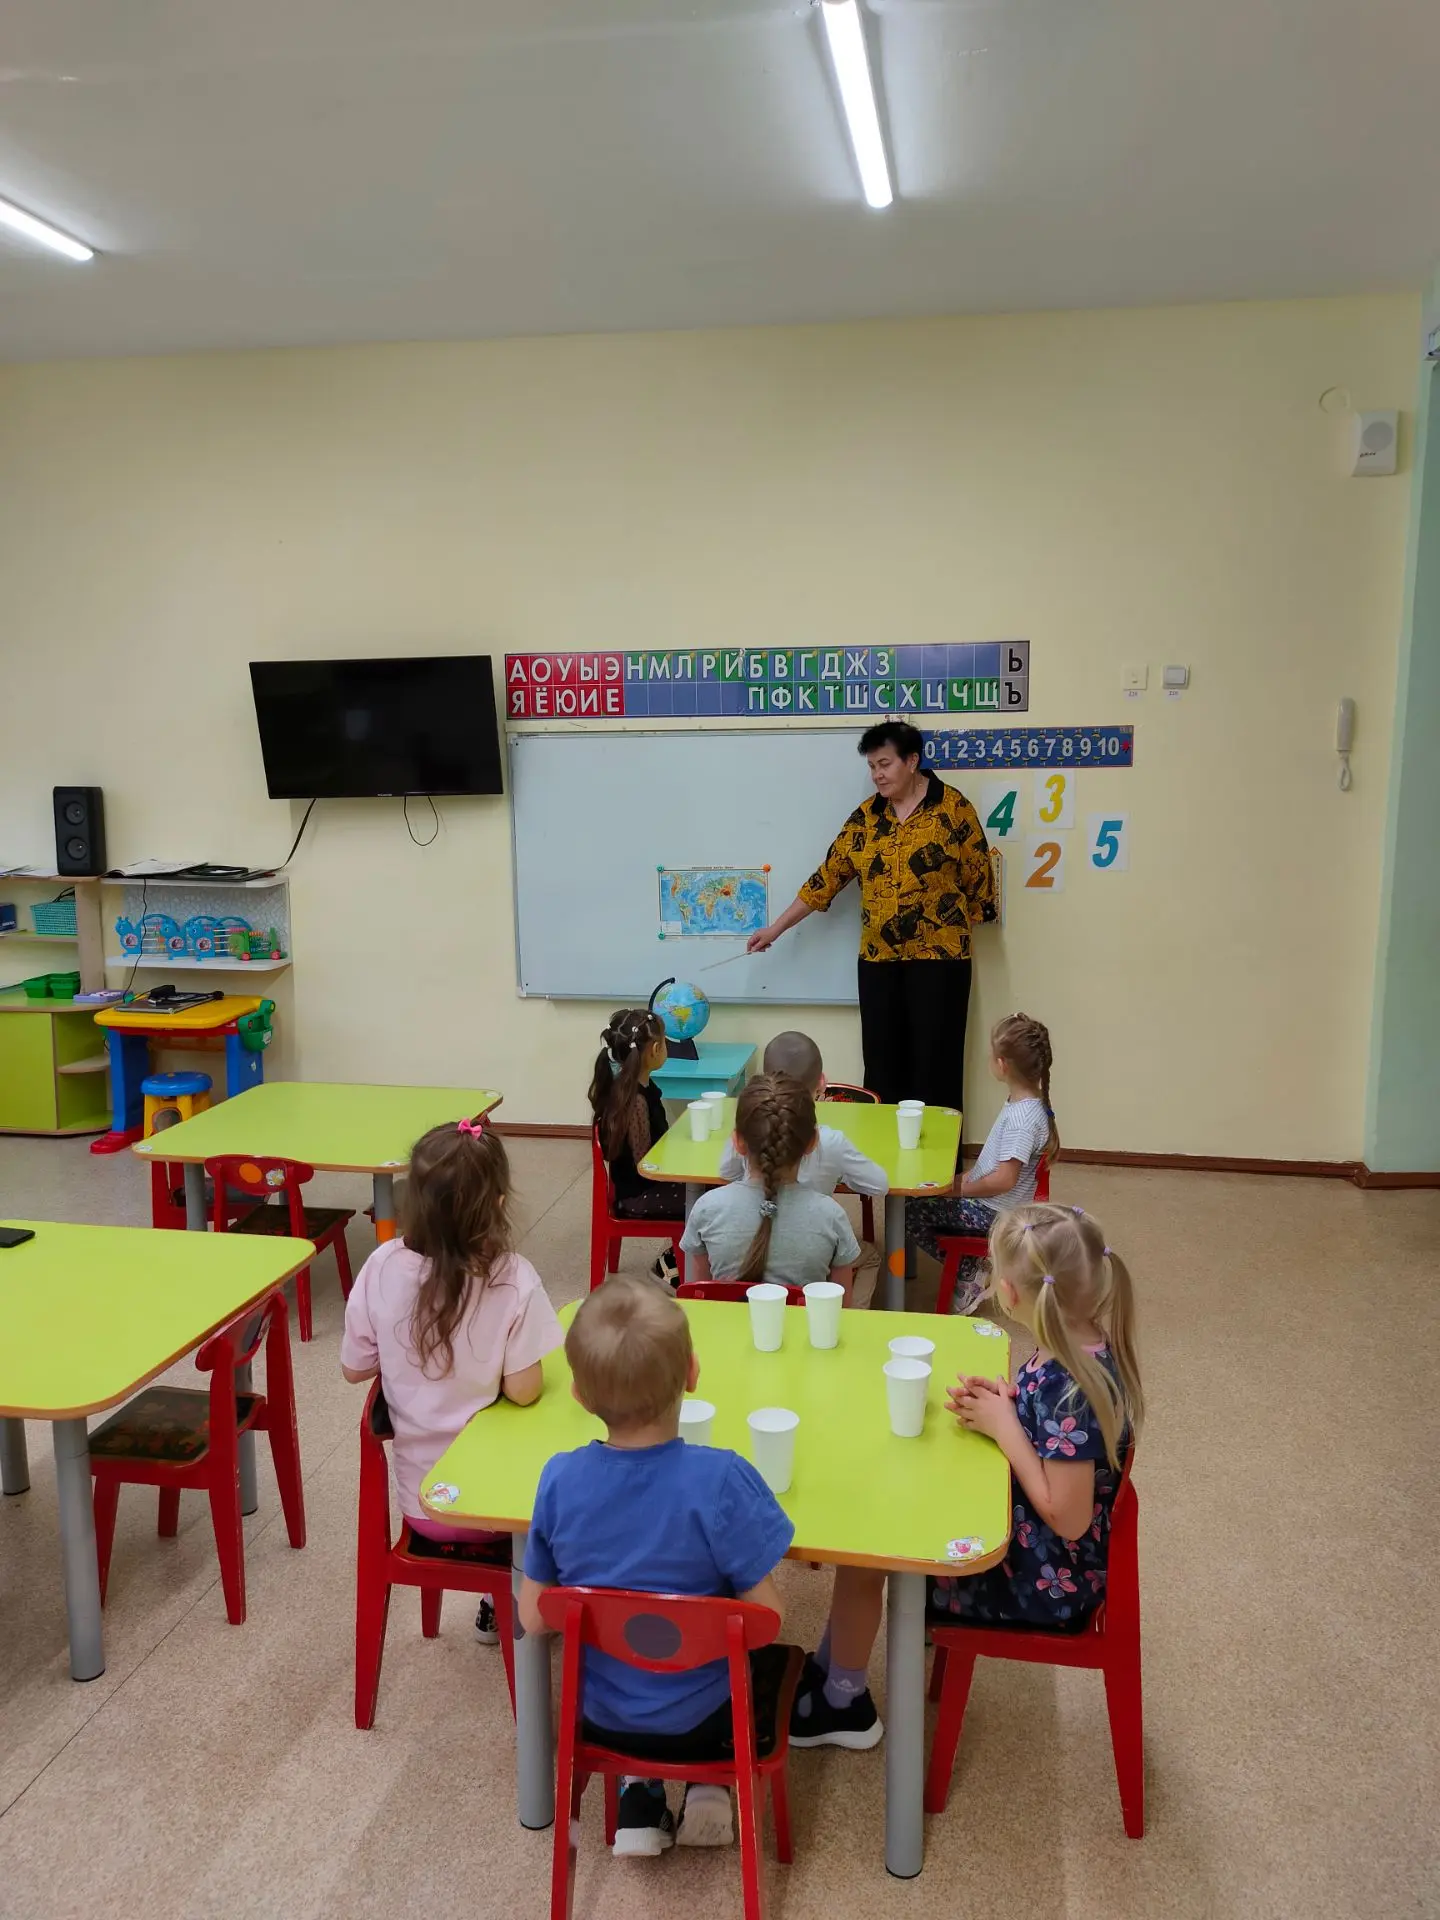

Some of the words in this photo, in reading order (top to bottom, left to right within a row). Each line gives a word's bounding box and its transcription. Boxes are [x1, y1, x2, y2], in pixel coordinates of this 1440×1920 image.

[924, 740, 936, 760] 0
[941, 740, 950, 759] 1
[957, 740, 969, 759] 2
[975, 740, 986, 758] 3
[991, 739, 1004, 758] 4
[1010, 739, 1022, 758] 5
[1027, 738, 1039, 758] 6
[1044, 738, 1056, 757] 7
[1062, 737, 1073, 757] 8
[1080, 737, 1092, 757] 9
[1097, 736, 1120, 756] 10
[986, 790, 1018, 837] 4
[1039, 773, 1067, 824] 3
[1024, 841, 1063, 889] 2
[1091, 819, 1124, 868] 5
